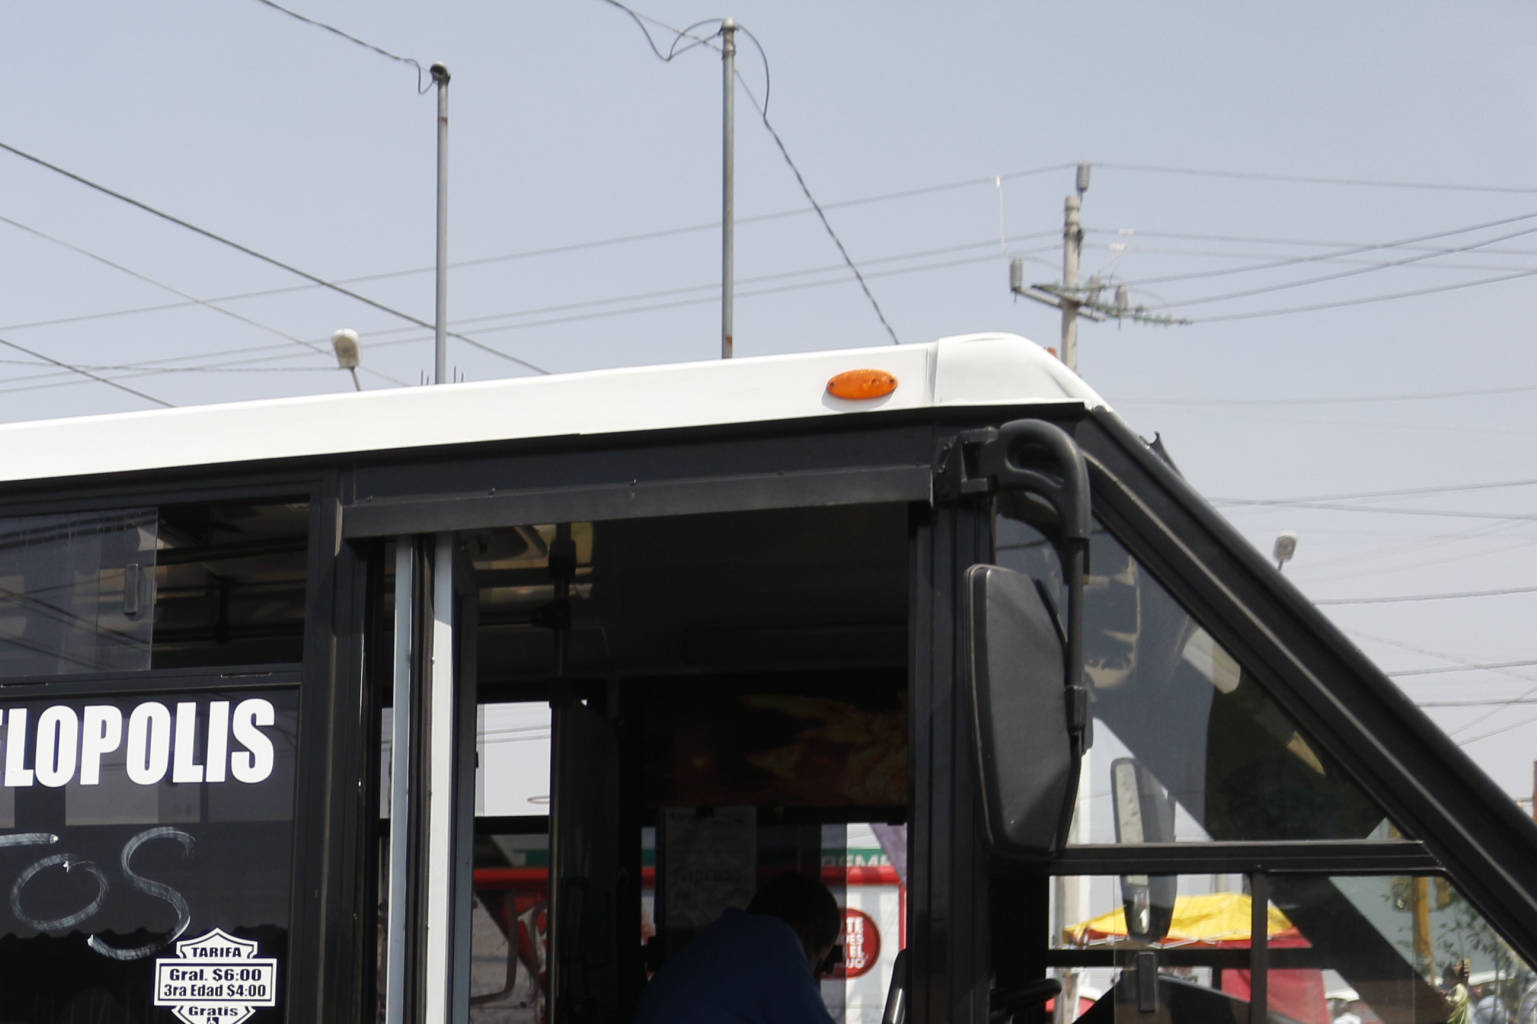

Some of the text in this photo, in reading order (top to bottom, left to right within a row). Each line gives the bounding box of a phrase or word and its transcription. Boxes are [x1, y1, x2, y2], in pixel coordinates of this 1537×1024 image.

[191, 947, 242, 958] TARIFA
[169, 968, 262, 982] Gral. $6:00
[164, 984, 266, 997] 3ra Edad $4:00
[188, 1006, 238, 1016] Gratis
